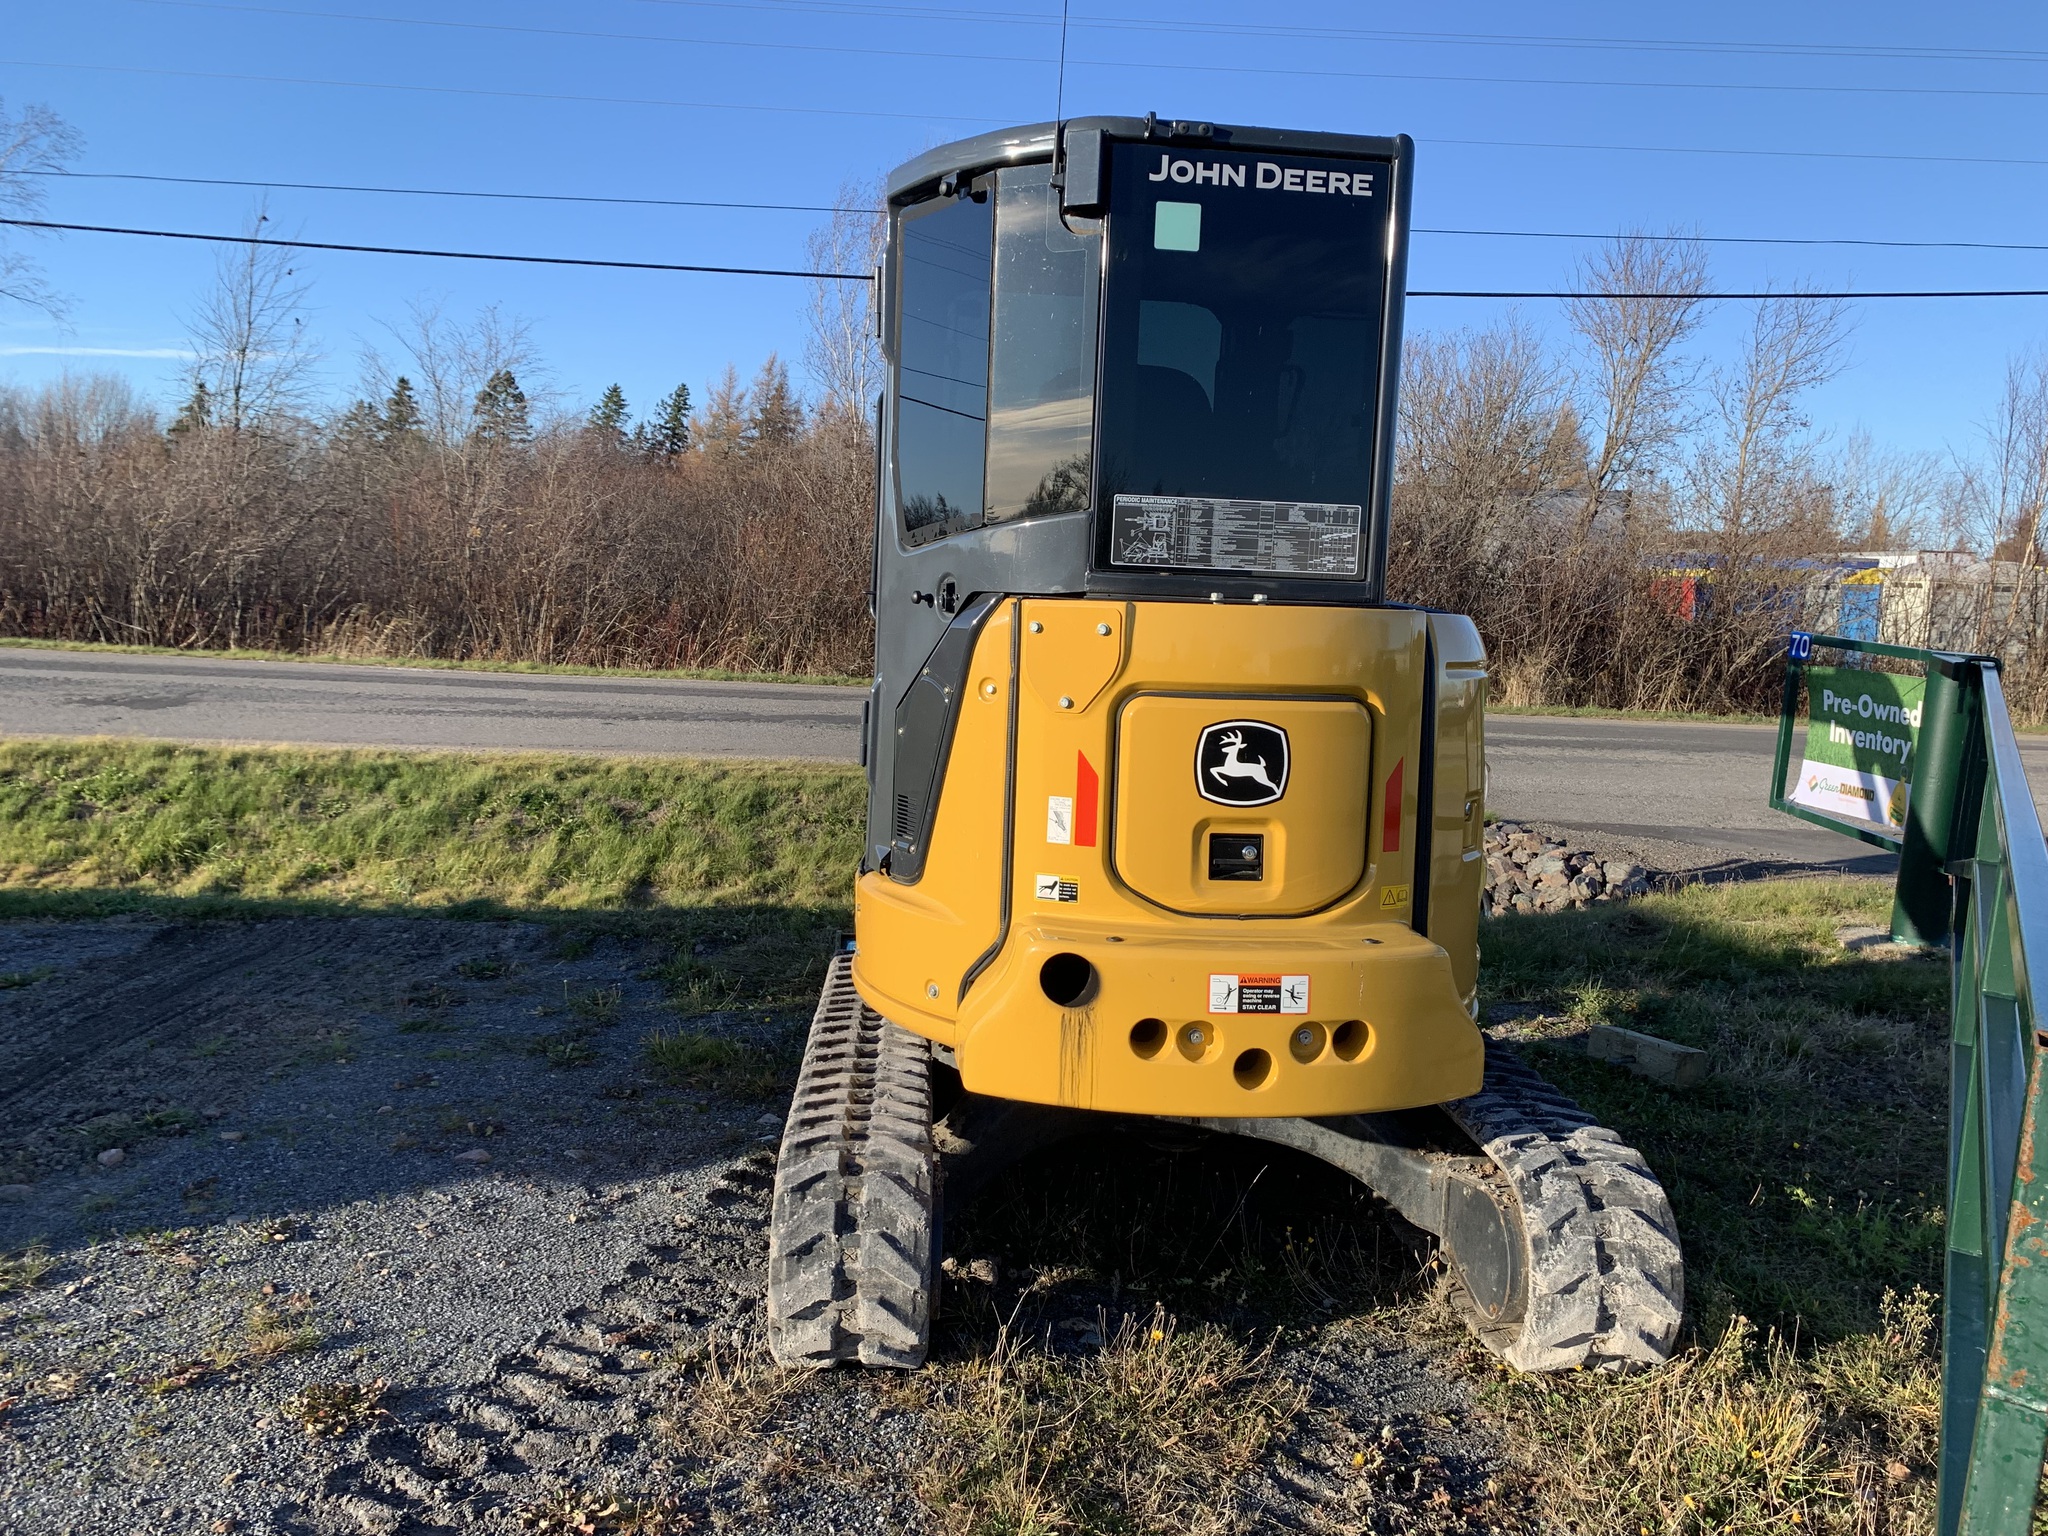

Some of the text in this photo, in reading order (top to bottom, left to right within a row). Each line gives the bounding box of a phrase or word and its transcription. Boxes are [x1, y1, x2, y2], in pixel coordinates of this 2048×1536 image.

[1149, 155, 1374, 196] JOHN DEERE
[1791, 634, 1810, 657] 70
[1823, 689, 1923, 727] Pre-Owned
[1829, 720, 1912, 765] Inventory
[1840, 782, 1875, 802] DIAMOND
